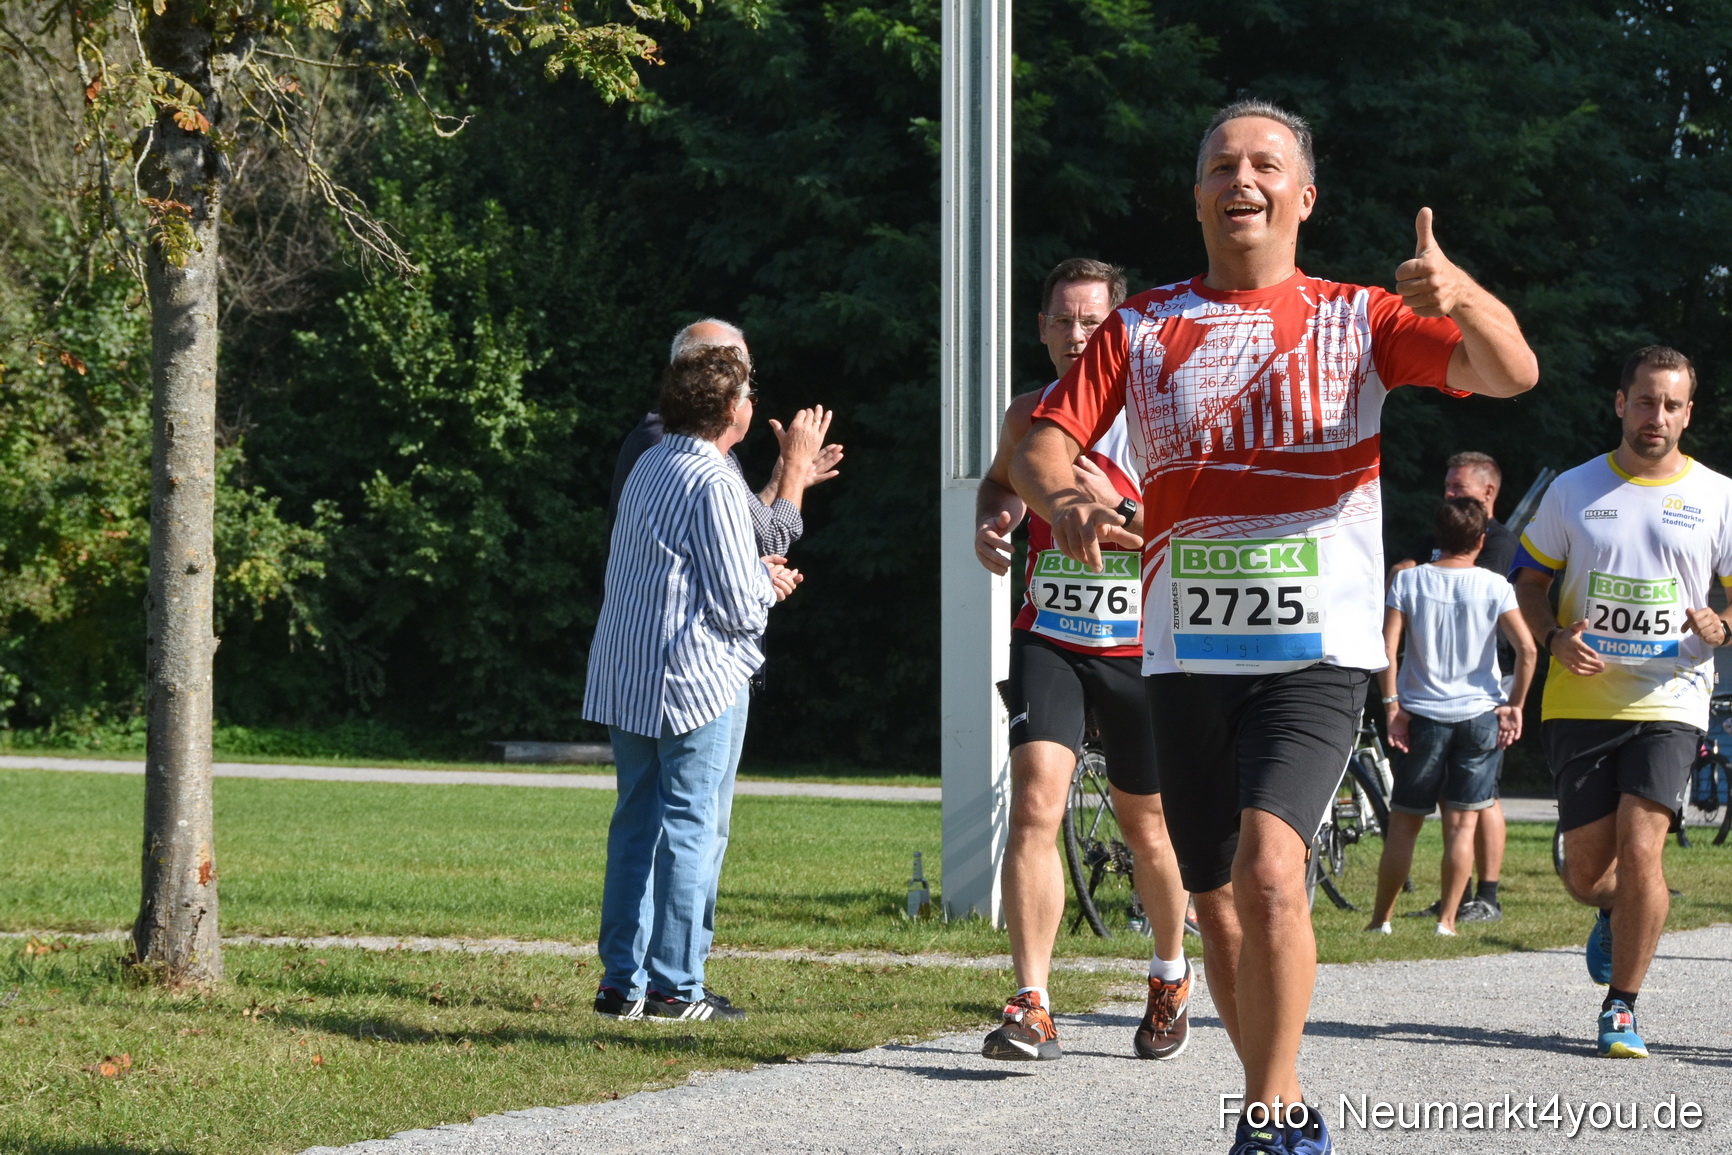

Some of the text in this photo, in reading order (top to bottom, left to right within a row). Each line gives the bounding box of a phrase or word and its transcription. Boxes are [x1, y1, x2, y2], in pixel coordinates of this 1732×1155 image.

[1199, 355, 1237, 369] 52.01
[1199, 374, 1238, 389] 26.22
[1665, 497, 1683, 510] 20
[1661, 517, 1696, 530] Stadtlauf
[1663, 510, 1705, 523] Neumarkter
[1043, 555, 1127, 575] BOK
[1183, 545, 1301, 571] BOCK
[1042, 582, 1128, 615] 2576
[1596, 578, 1668, 600] BOCK
[1187, 585, 1304, 626] 2725
[1059, 617, 1114, 636] OLIVER
[1593, 604, 1670, 635] 2045
[1201, 636, 1260, 658] Sigi
[1597, 639, 1663, 656] THOMAS
